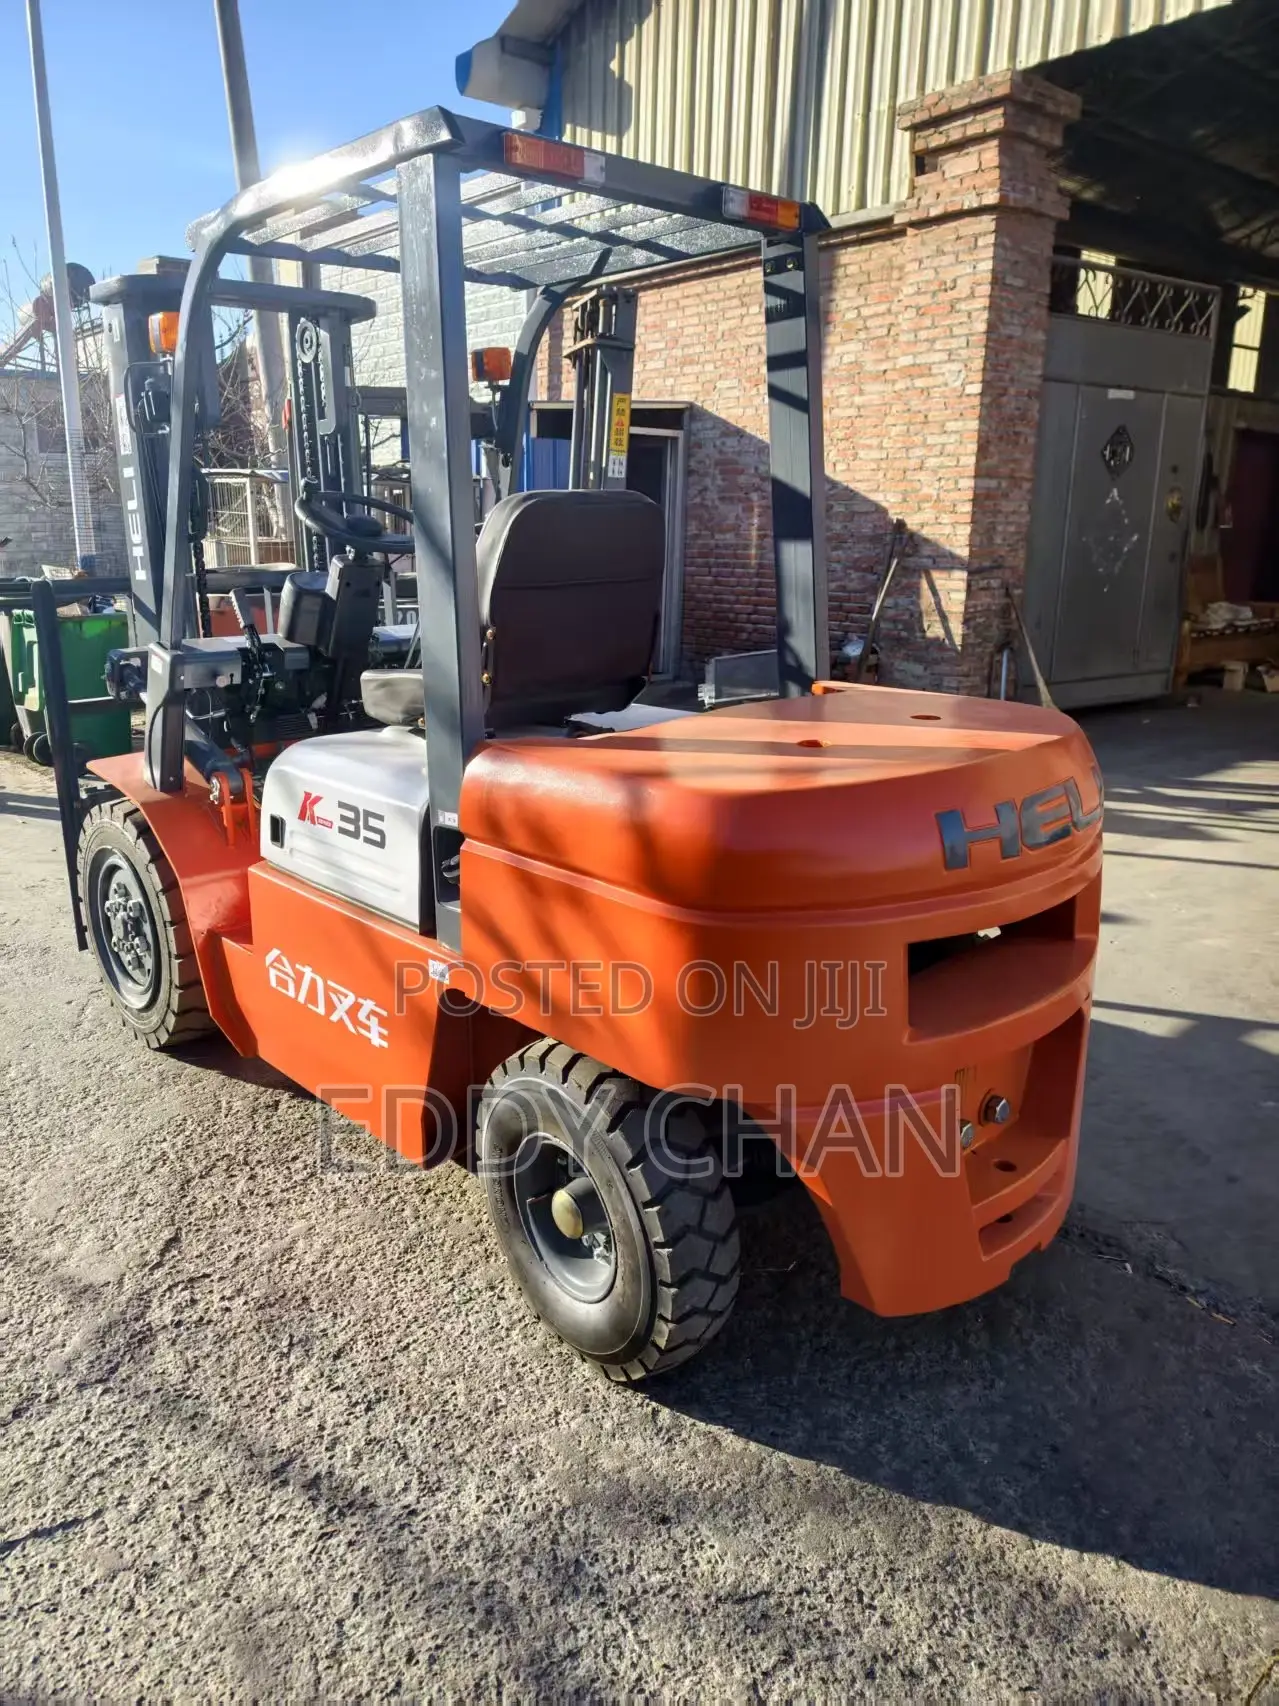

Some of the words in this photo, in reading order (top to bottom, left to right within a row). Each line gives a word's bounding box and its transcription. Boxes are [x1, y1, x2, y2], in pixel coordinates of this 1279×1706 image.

[122, 466, 147, 581] HELI
[298, 790, 323, 826] K
[337, 800, 387, 850] 35
[935, 765, 1104, 871] HEL
[265, 947, 389, 1049] 合力叉车
